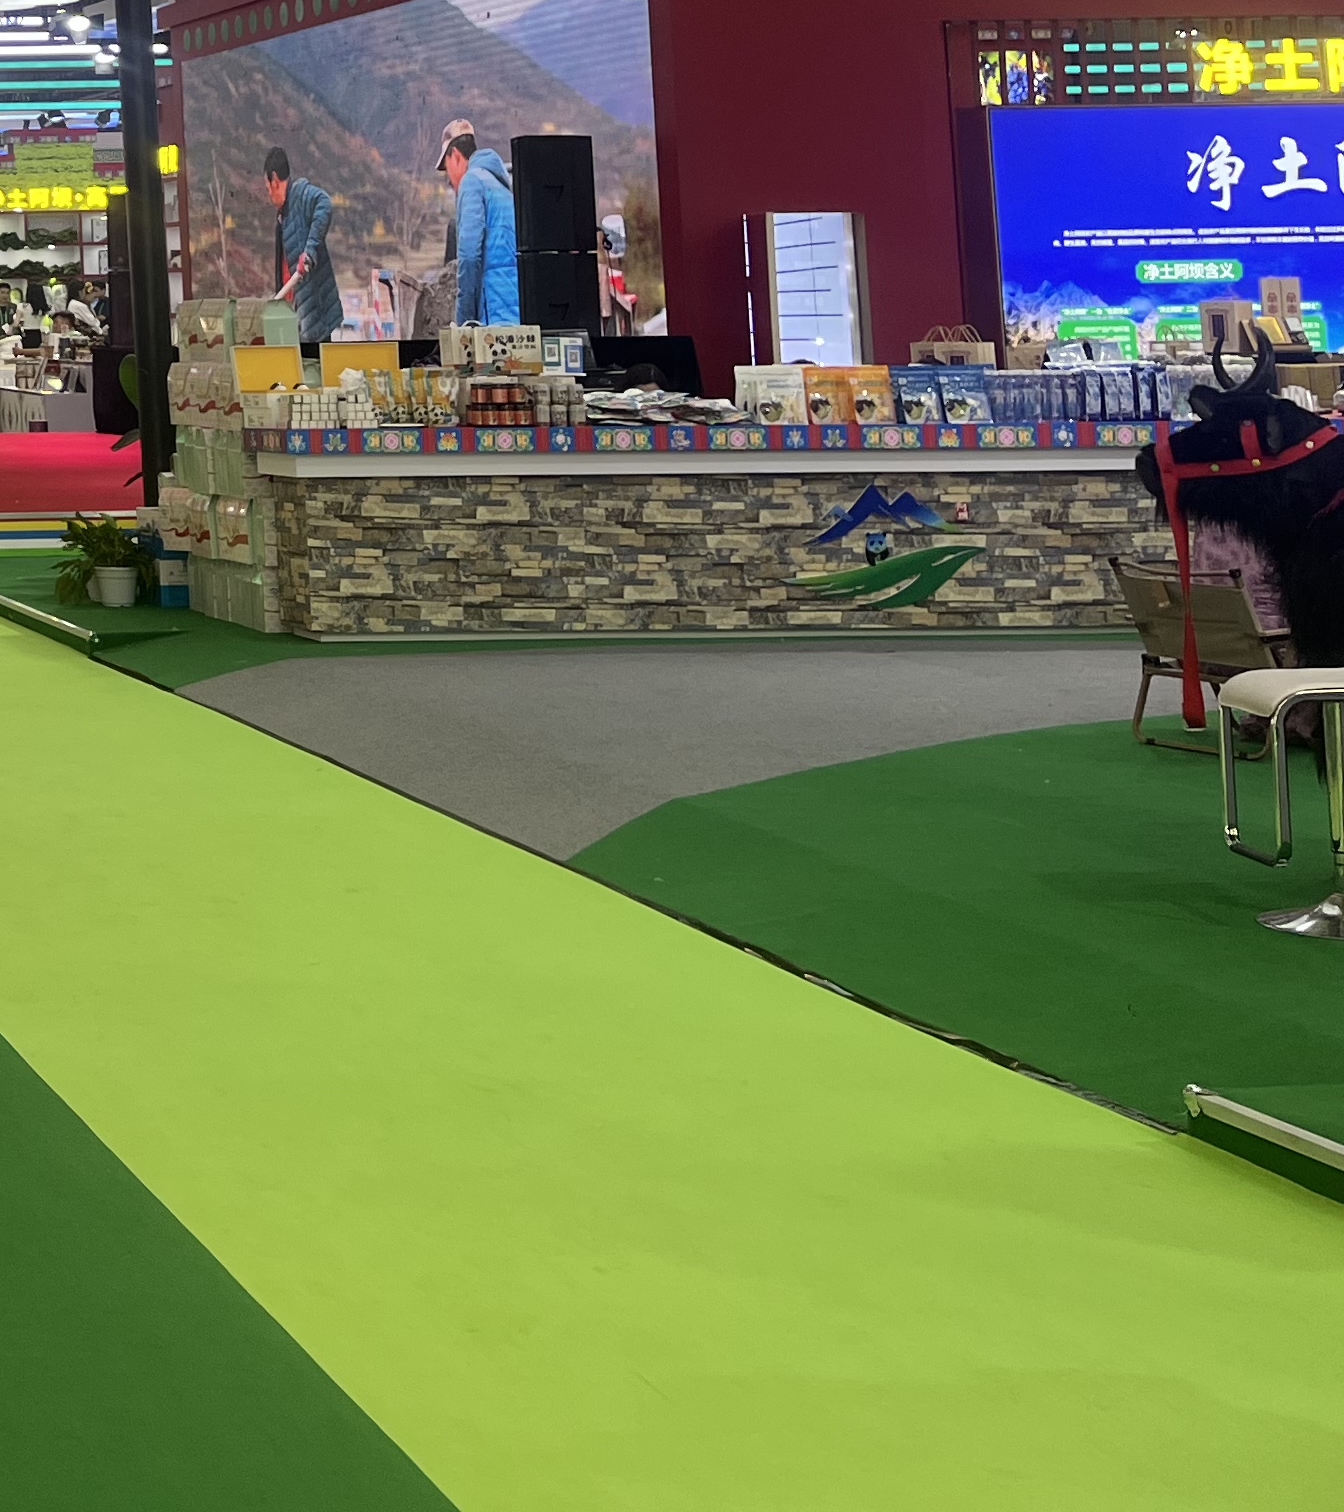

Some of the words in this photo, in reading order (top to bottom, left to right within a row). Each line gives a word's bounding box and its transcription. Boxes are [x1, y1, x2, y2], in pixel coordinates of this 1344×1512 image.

[1186, 134, 1344, 212] 净土
[1142, 261, 1236, 281] 净土阿坝含义
